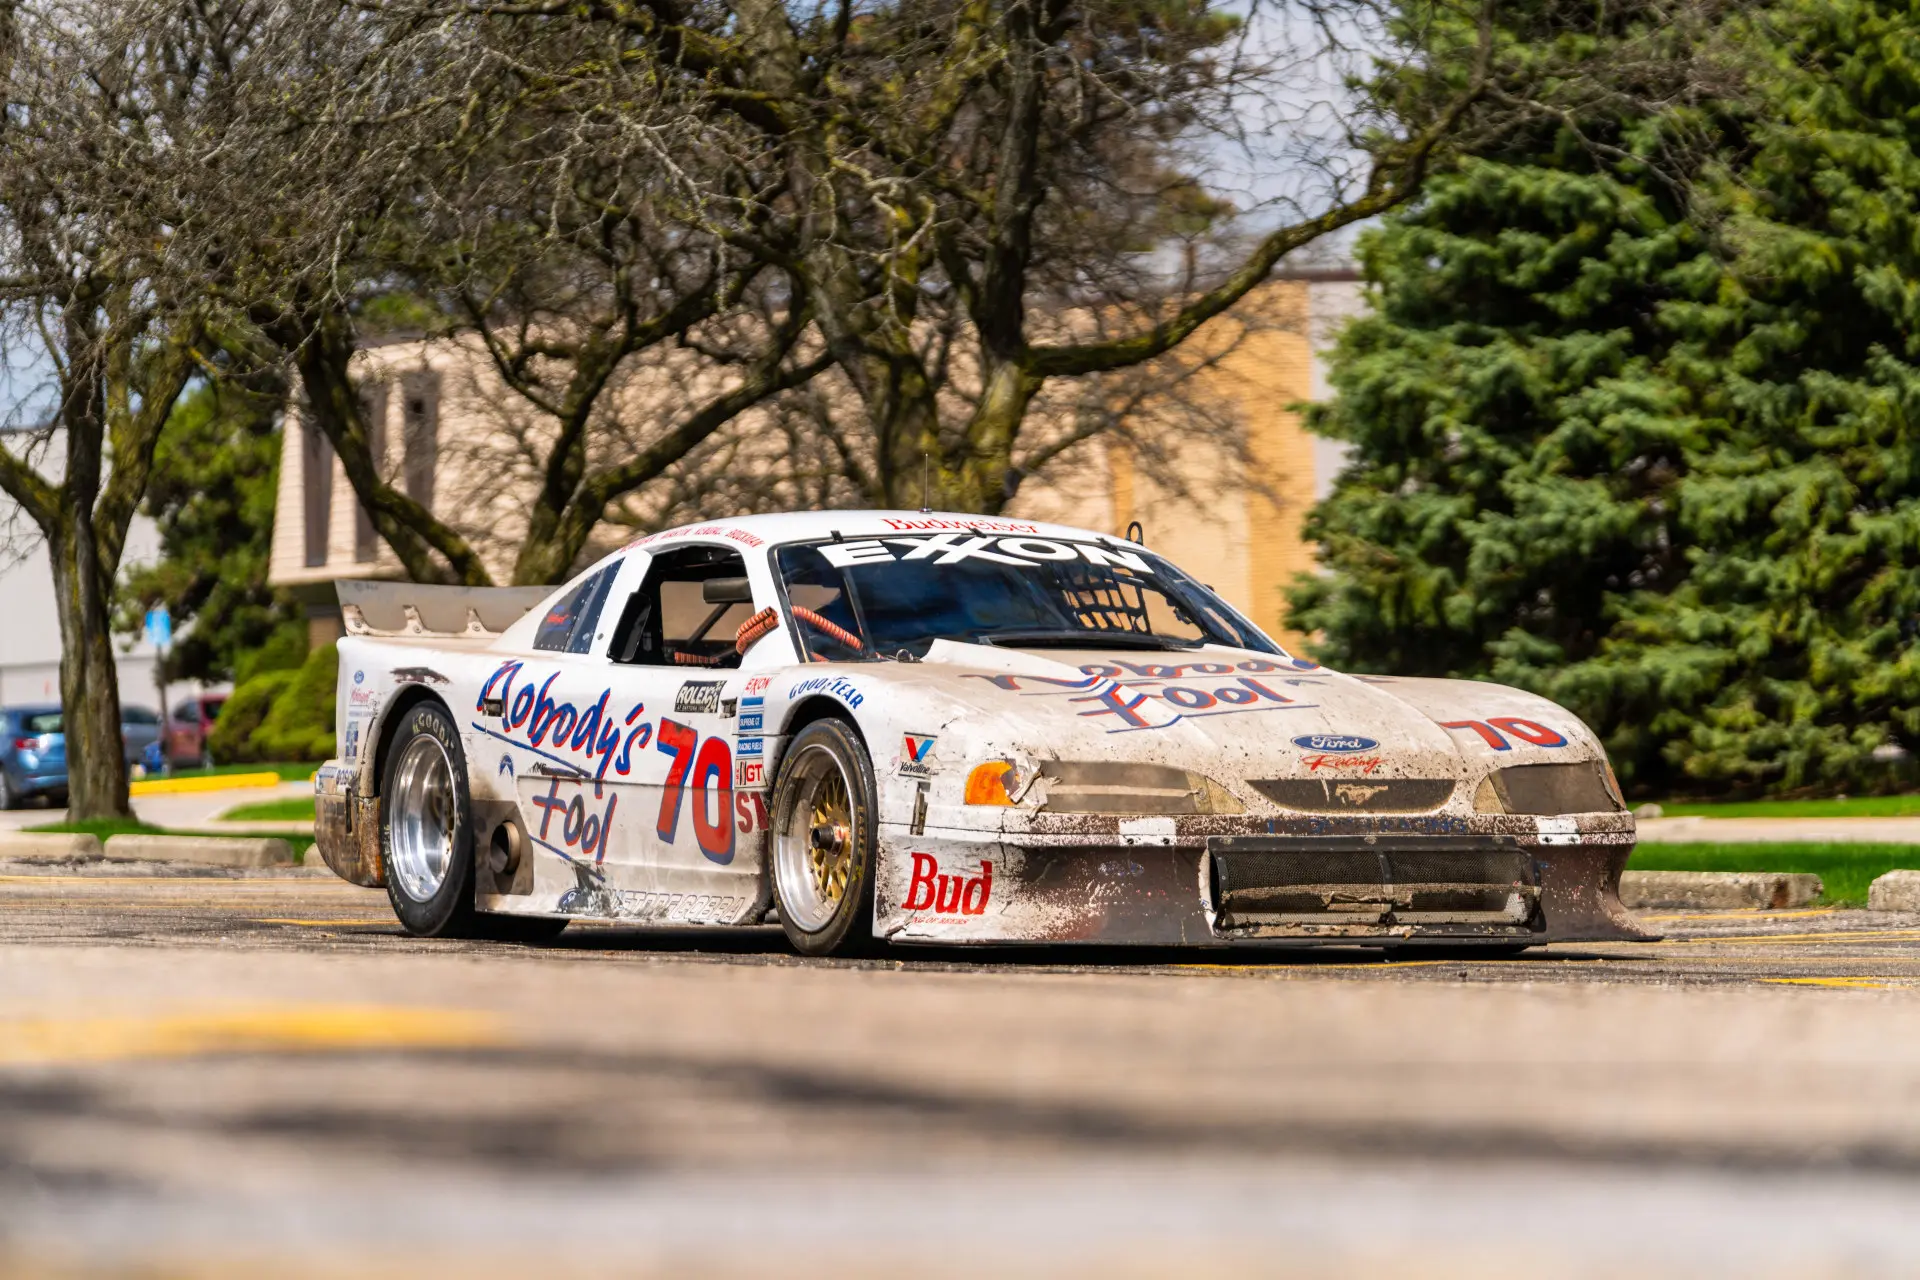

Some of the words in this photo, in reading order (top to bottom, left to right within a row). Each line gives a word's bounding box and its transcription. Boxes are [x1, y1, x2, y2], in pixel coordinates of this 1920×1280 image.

[881, 518, 1040, 534] Budweiser
[817, 533, 1155, 573] EXXON
[677, 685, 714, 704] ROLEX
[789, 676, 864, 710] GOODYEAR
[1311, 736, 1362, 749] Ford
[1438, 717, 1568, 751] 70
[746, 763, 763, 782] GT
[900, 761, 930, 774] Valvoline
[1302, 755, 1388, 774] Racing
[656, 717, 736, 866] 70
[532, 775, 618, 865] Fool
[901, 852, 993, 916] Bud
[679, 894, 746, 921] COBRA
